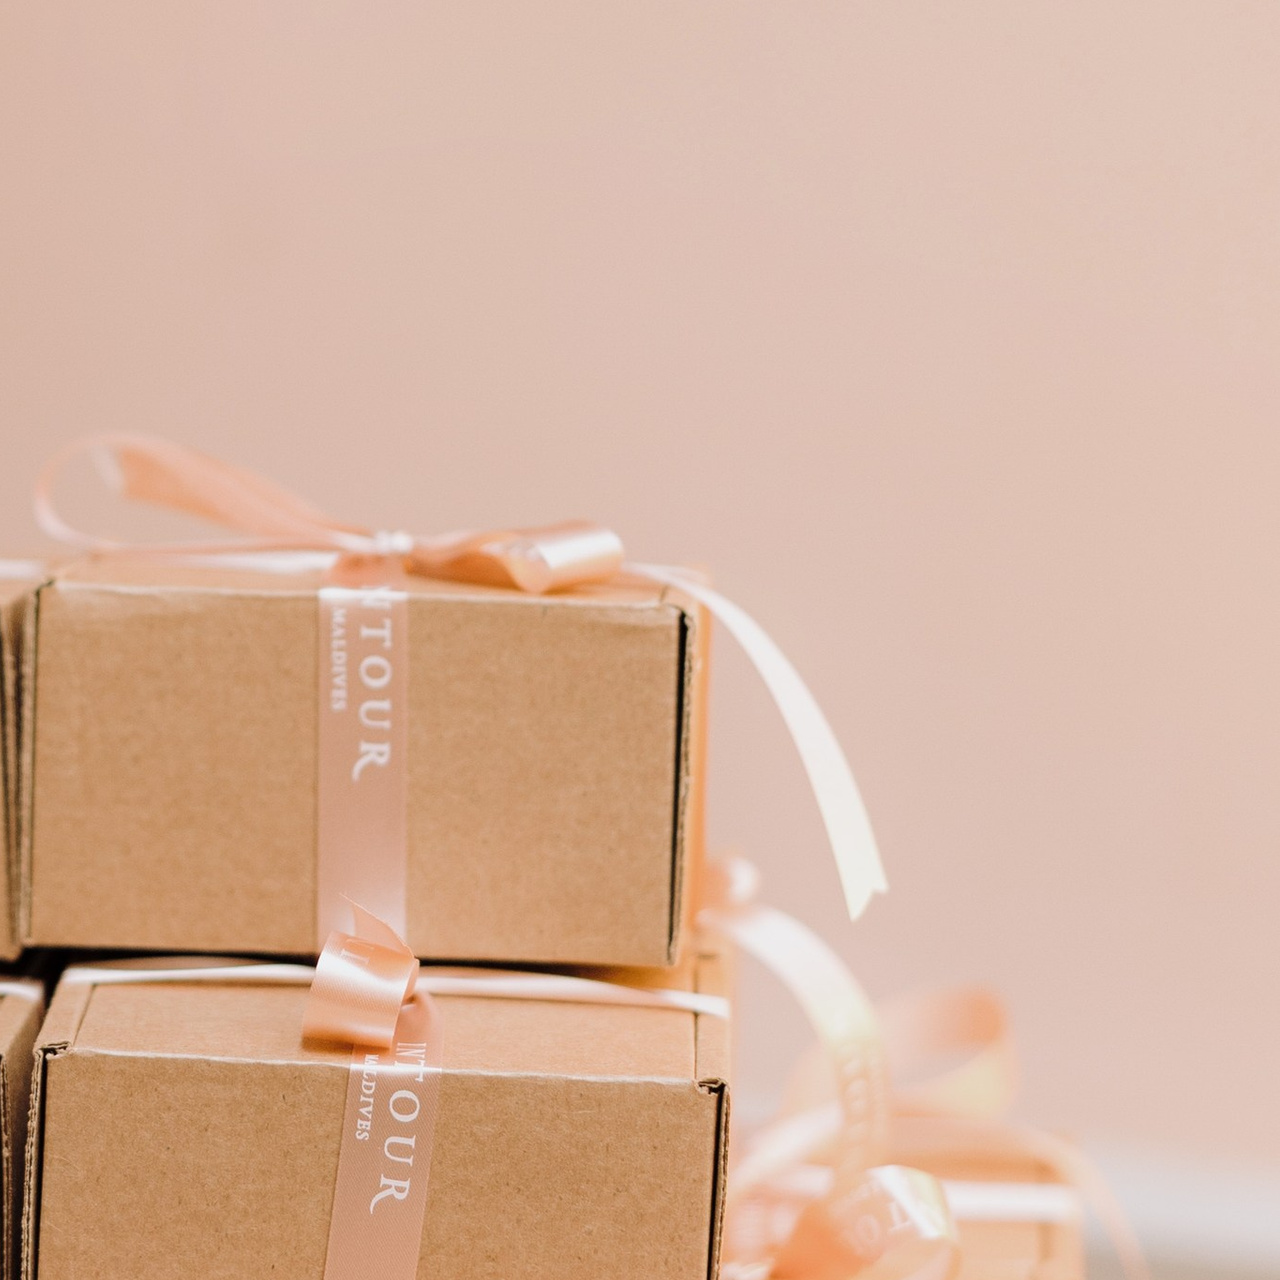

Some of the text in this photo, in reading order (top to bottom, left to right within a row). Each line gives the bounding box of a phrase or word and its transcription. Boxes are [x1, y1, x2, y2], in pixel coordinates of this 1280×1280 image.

[331, 608, 347, 711] MALDIVES
[355, 1054, 380, 1142] MALDIVES
[368, 1042, 427, 1215] INTOUR
